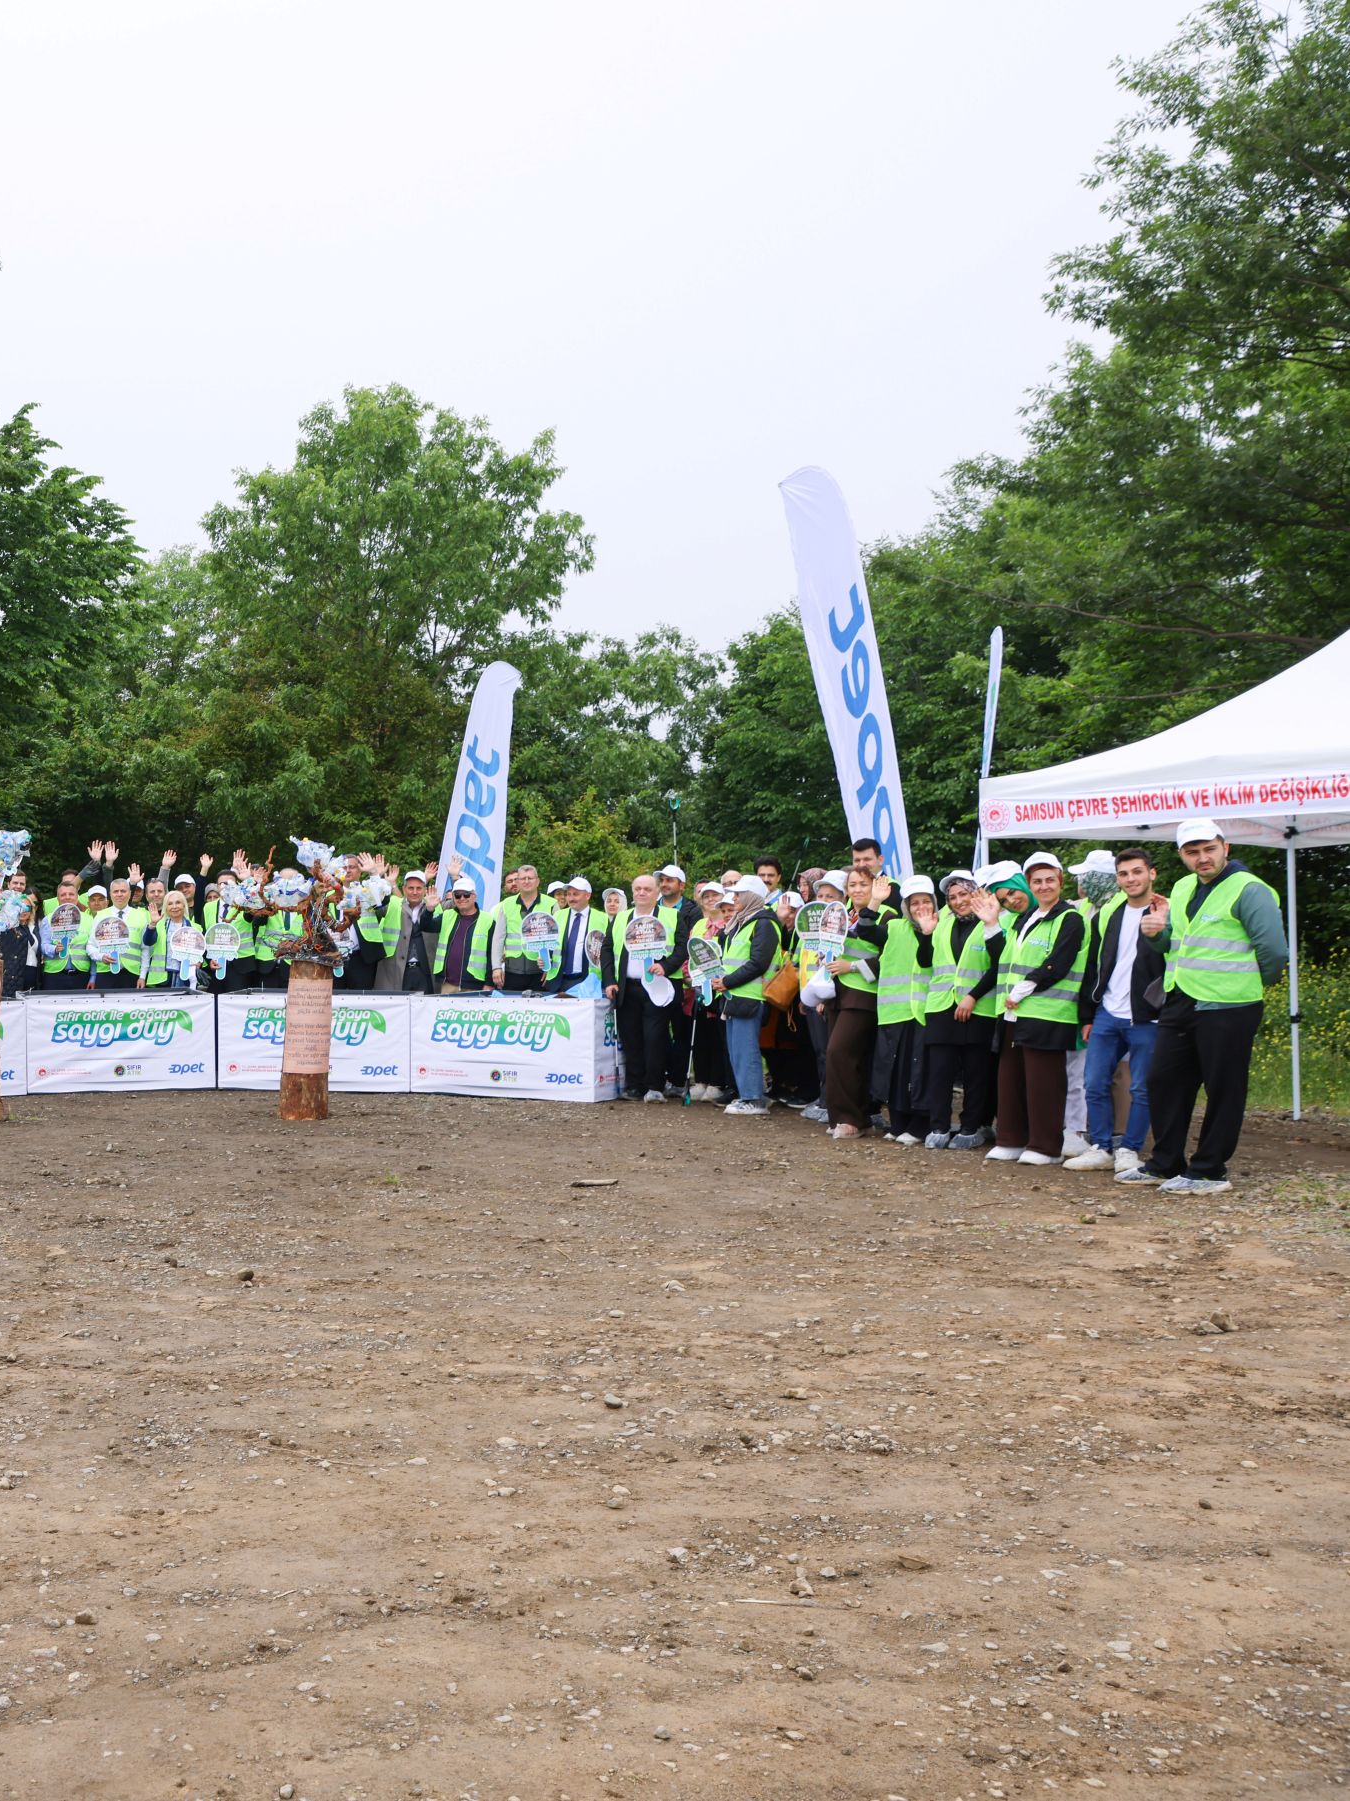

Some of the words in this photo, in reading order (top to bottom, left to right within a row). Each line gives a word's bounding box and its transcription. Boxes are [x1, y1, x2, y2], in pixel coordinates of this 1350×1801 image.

[1014, 801, 1064, 823] SAMSUN
[1067, 797, 1109, 823] ÇEVRE
[1112, 787, 1187, 819] ŞEHİRCİLİK
[1191, 788, 1210, 808] VE
[1213, 781, 1255, 807] İKLİM
[1259, 773, 1350, 806] DEĞİŞİKLİĞ
[129, 1008, 178, 1023] doğaya
[331, 1007, 371, 1022] oğaya
[507, 1010, 556, 1026] doğaya
[53, 1021, 122, 1047] saygı
[126, 1020, 175, 1045] duy
[244, 1019, 285, 1045] say
[433, 1022, 500, 1049] saygı
[503, 1021, 553, 1051] duy
[168, 1062, 205, 1074] opet
[360, 1064, 398, 1077] opet
[545, 1072, 583, 1085] opet
